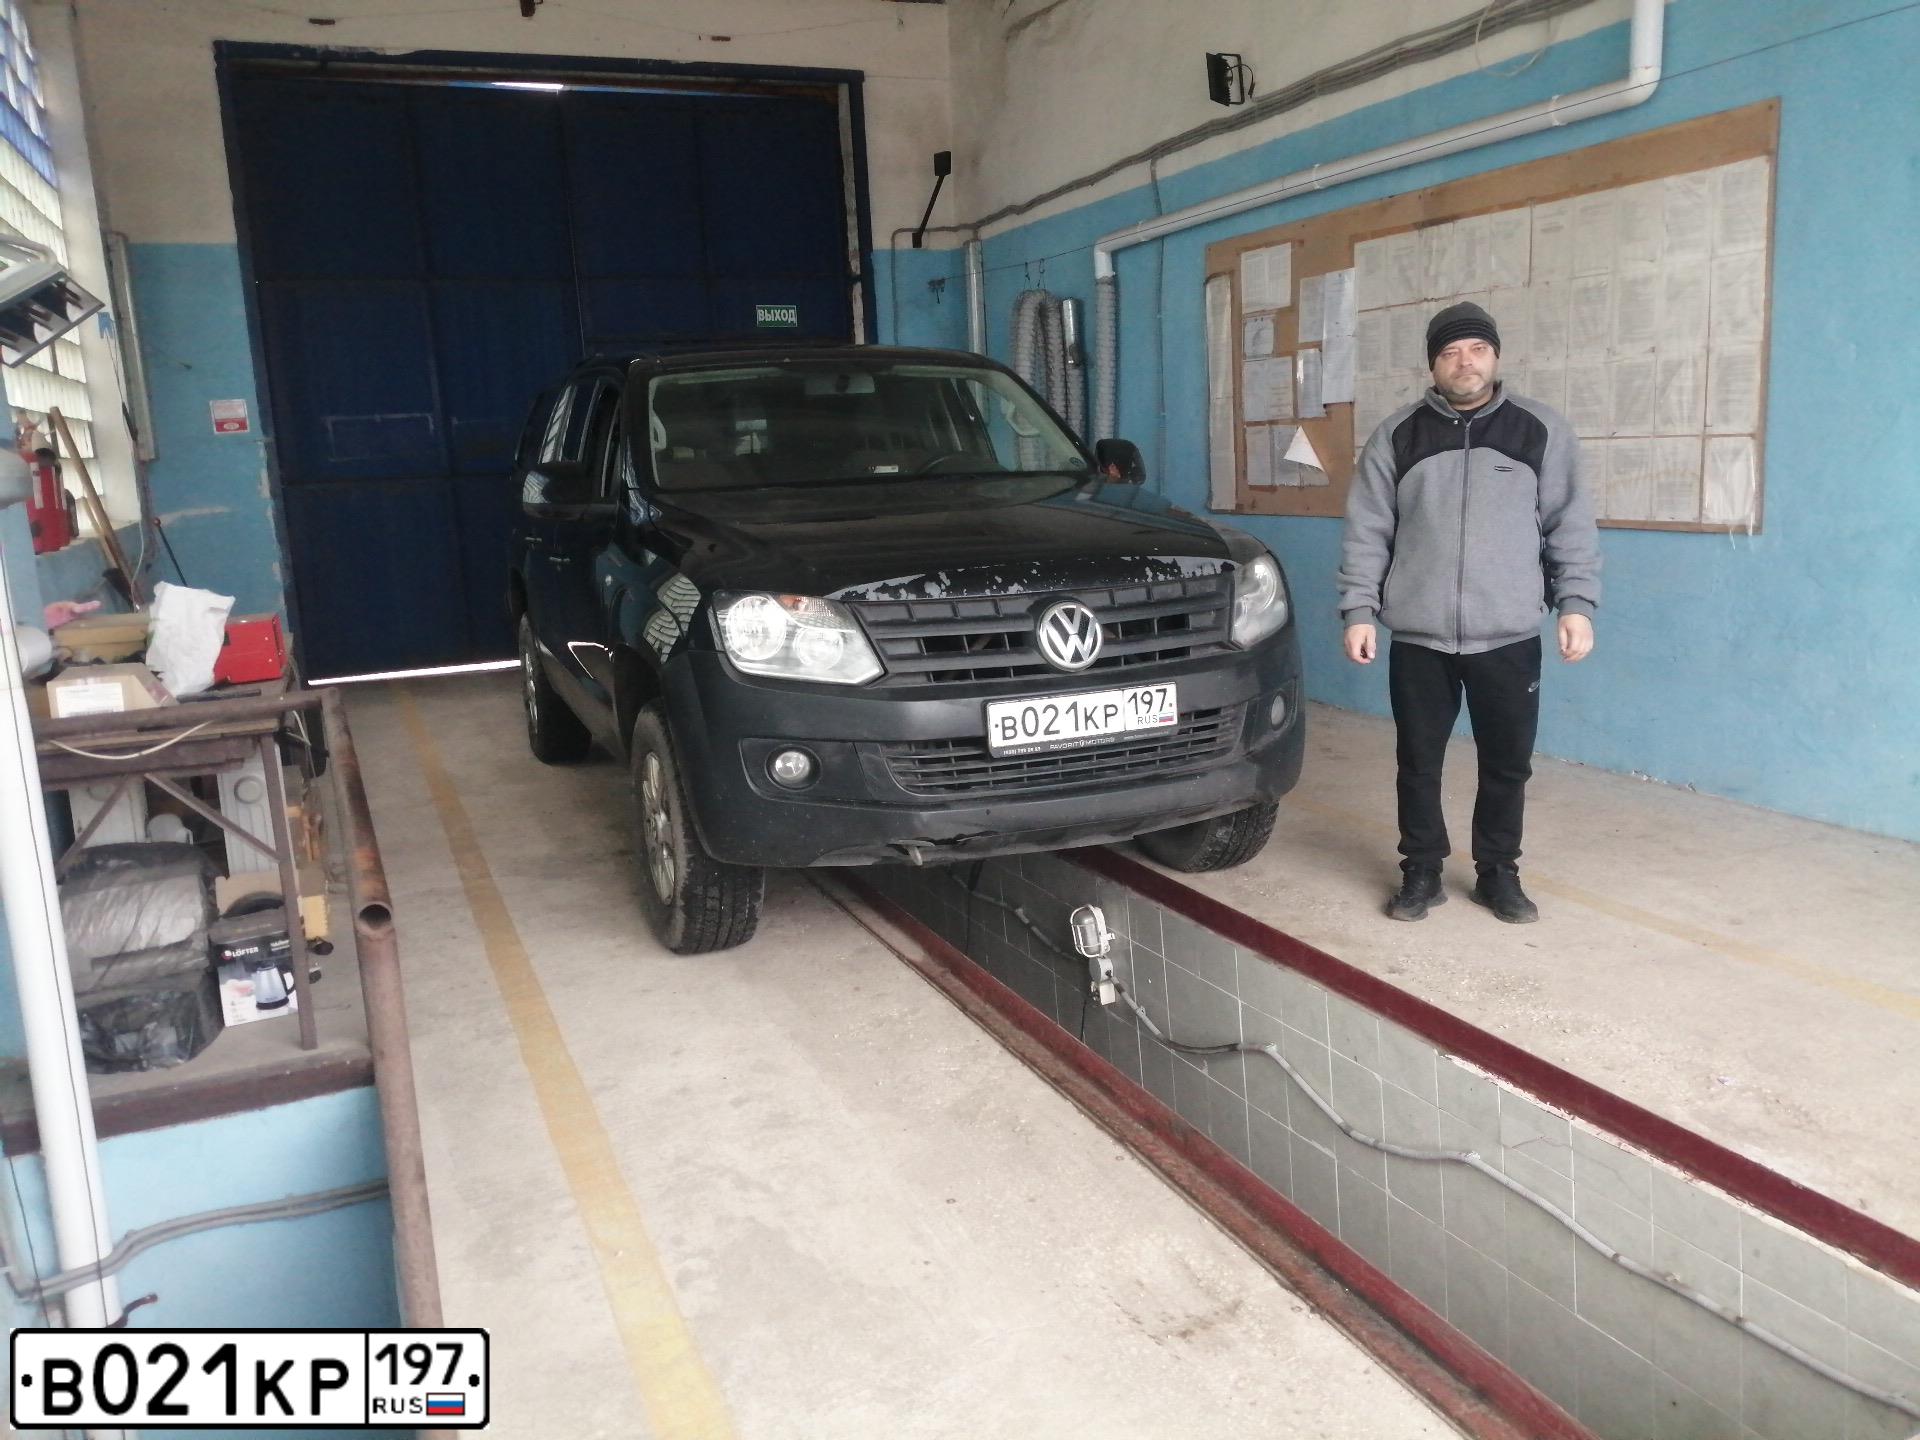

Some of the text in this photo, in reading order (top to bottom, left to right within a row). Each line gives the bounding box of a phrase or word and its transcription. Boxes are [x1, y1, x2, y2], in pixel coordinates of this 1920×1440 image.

[757, 309, 796, 323] ВЫХОД
[1127, 688, 1168, 715] 197
[1137, 714, 1158, 725] RUS
